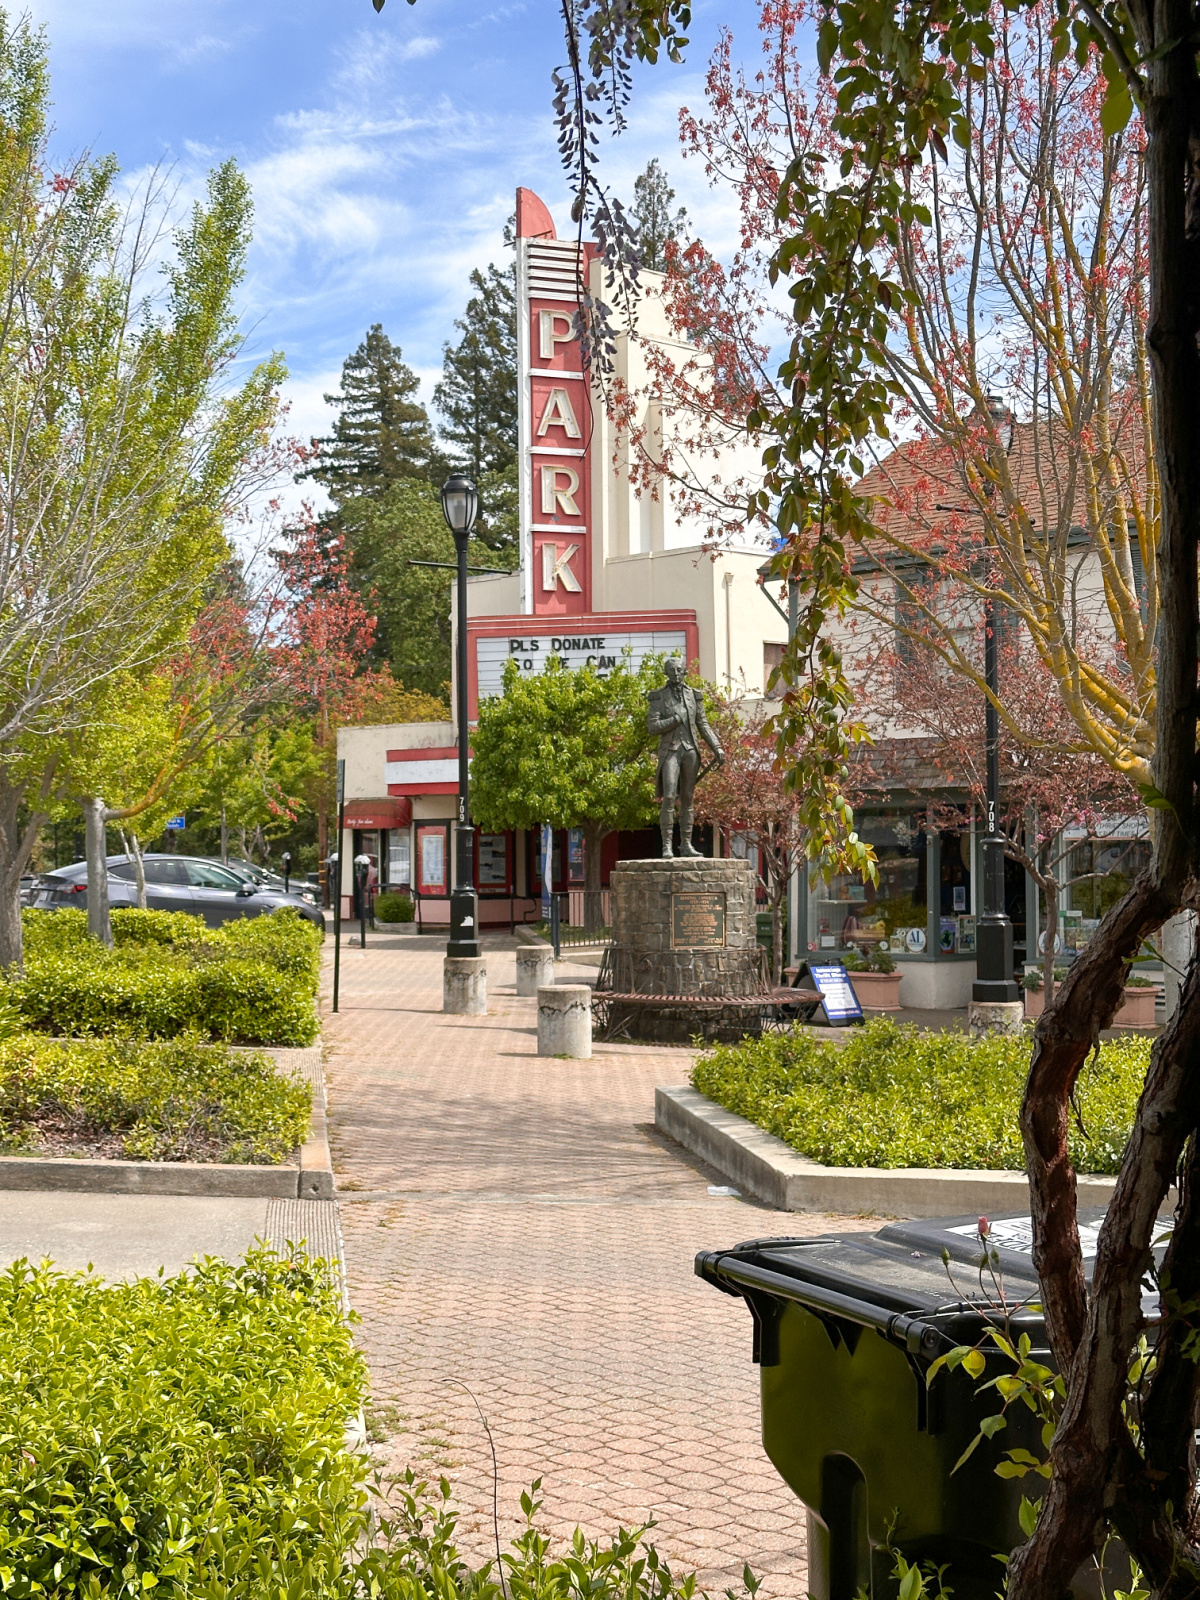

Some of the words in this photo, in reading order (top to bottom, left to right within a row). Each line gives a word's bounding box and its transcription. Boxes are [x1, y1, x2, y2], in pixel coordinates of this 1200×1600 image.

[536, 309, 583, 593] PARK
[510, 639, 539, 653] PLS
[551, 637, 605, 651] DONATE
[586, 655, 615, 669] CAN
